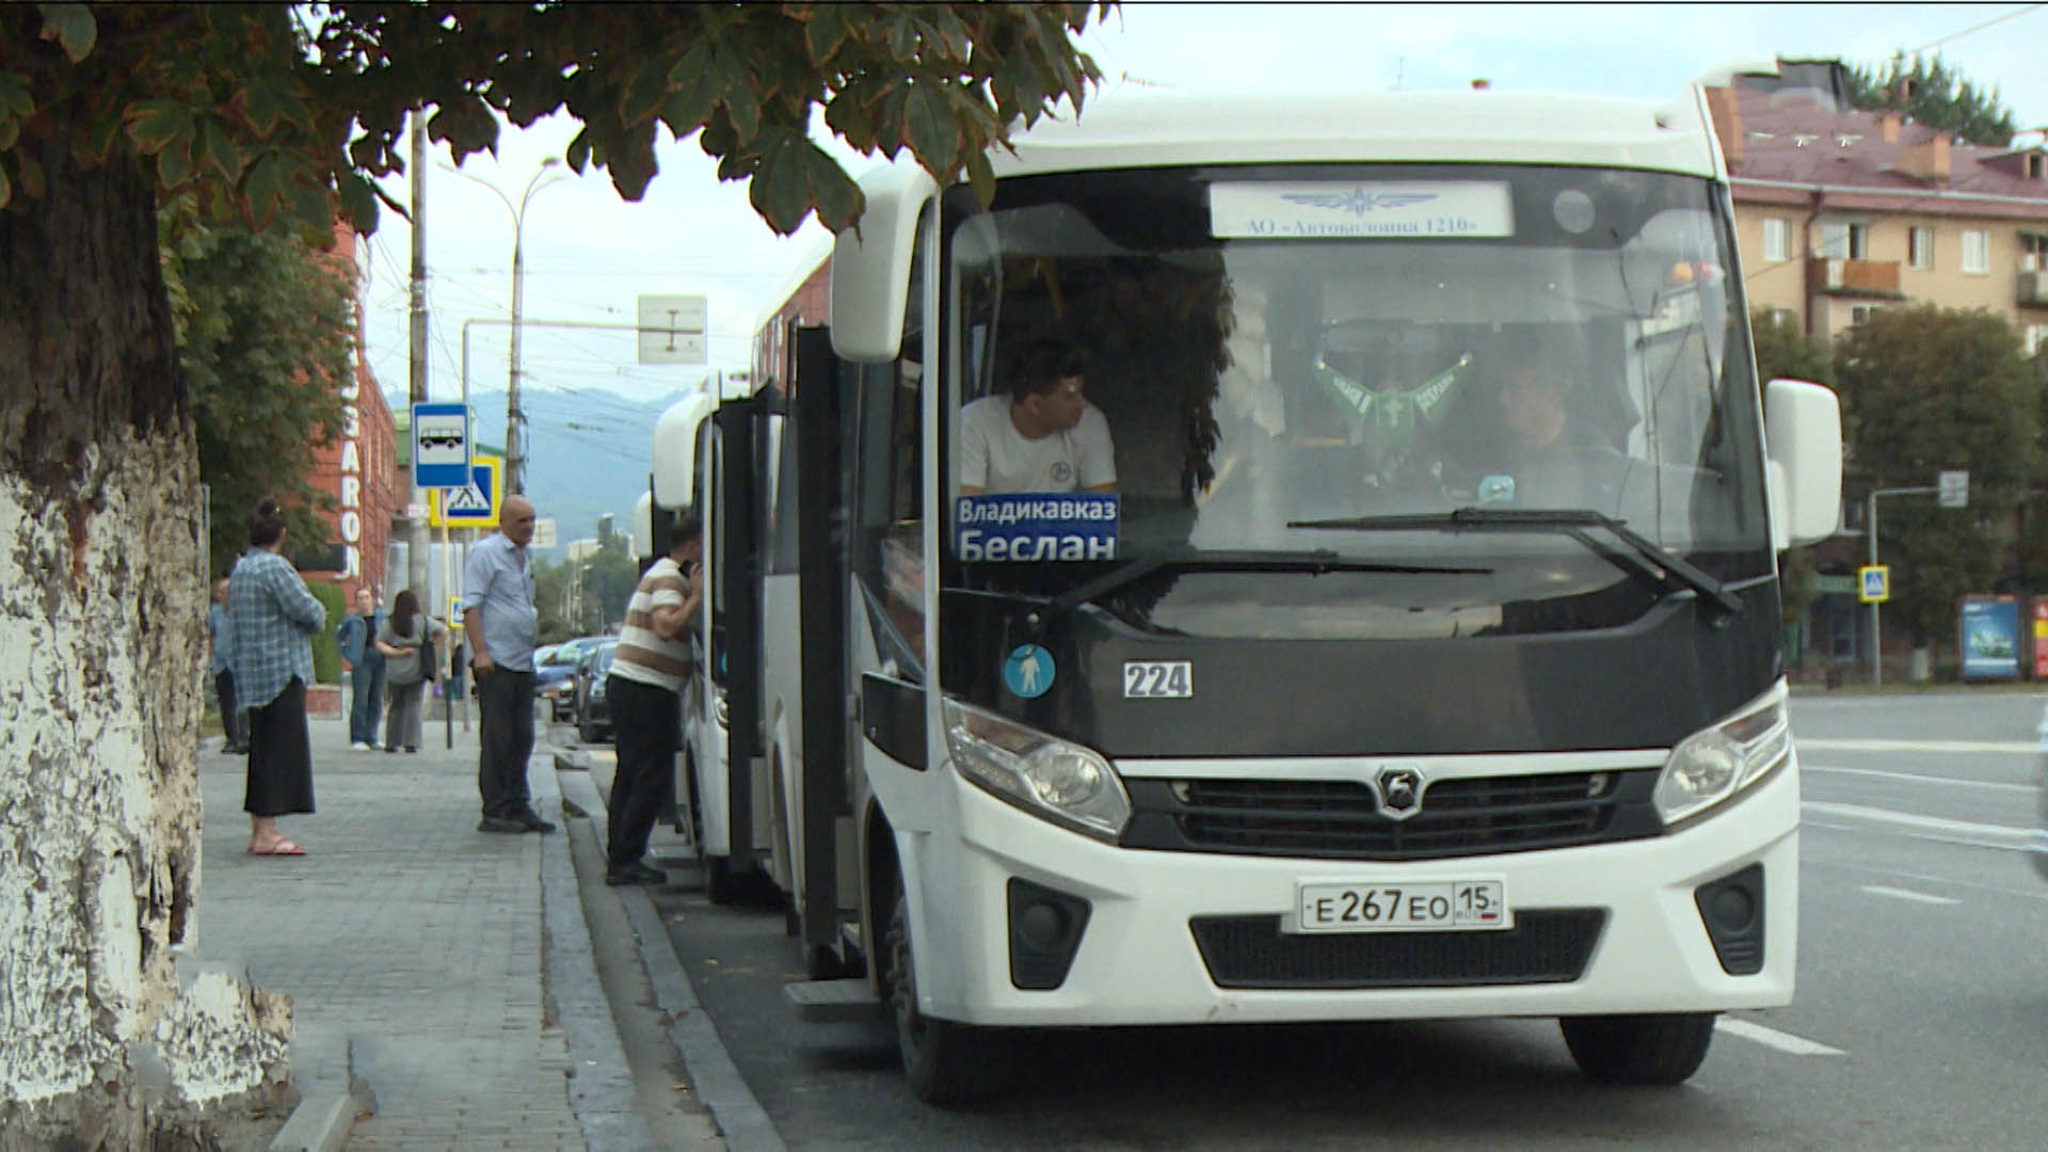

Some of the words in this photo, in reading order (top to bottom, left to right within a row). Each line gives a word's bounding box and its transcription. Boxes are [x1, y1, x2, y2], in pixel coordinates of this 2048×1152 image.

[1248, 220, 1276, 235] АО
[959, 500, 1117, 525] Владикавказ
[960, 530, 1115, 562] Беслан
[1127, 664, 1188, 696] 224
[1459, 886, 1489, 910] 15
